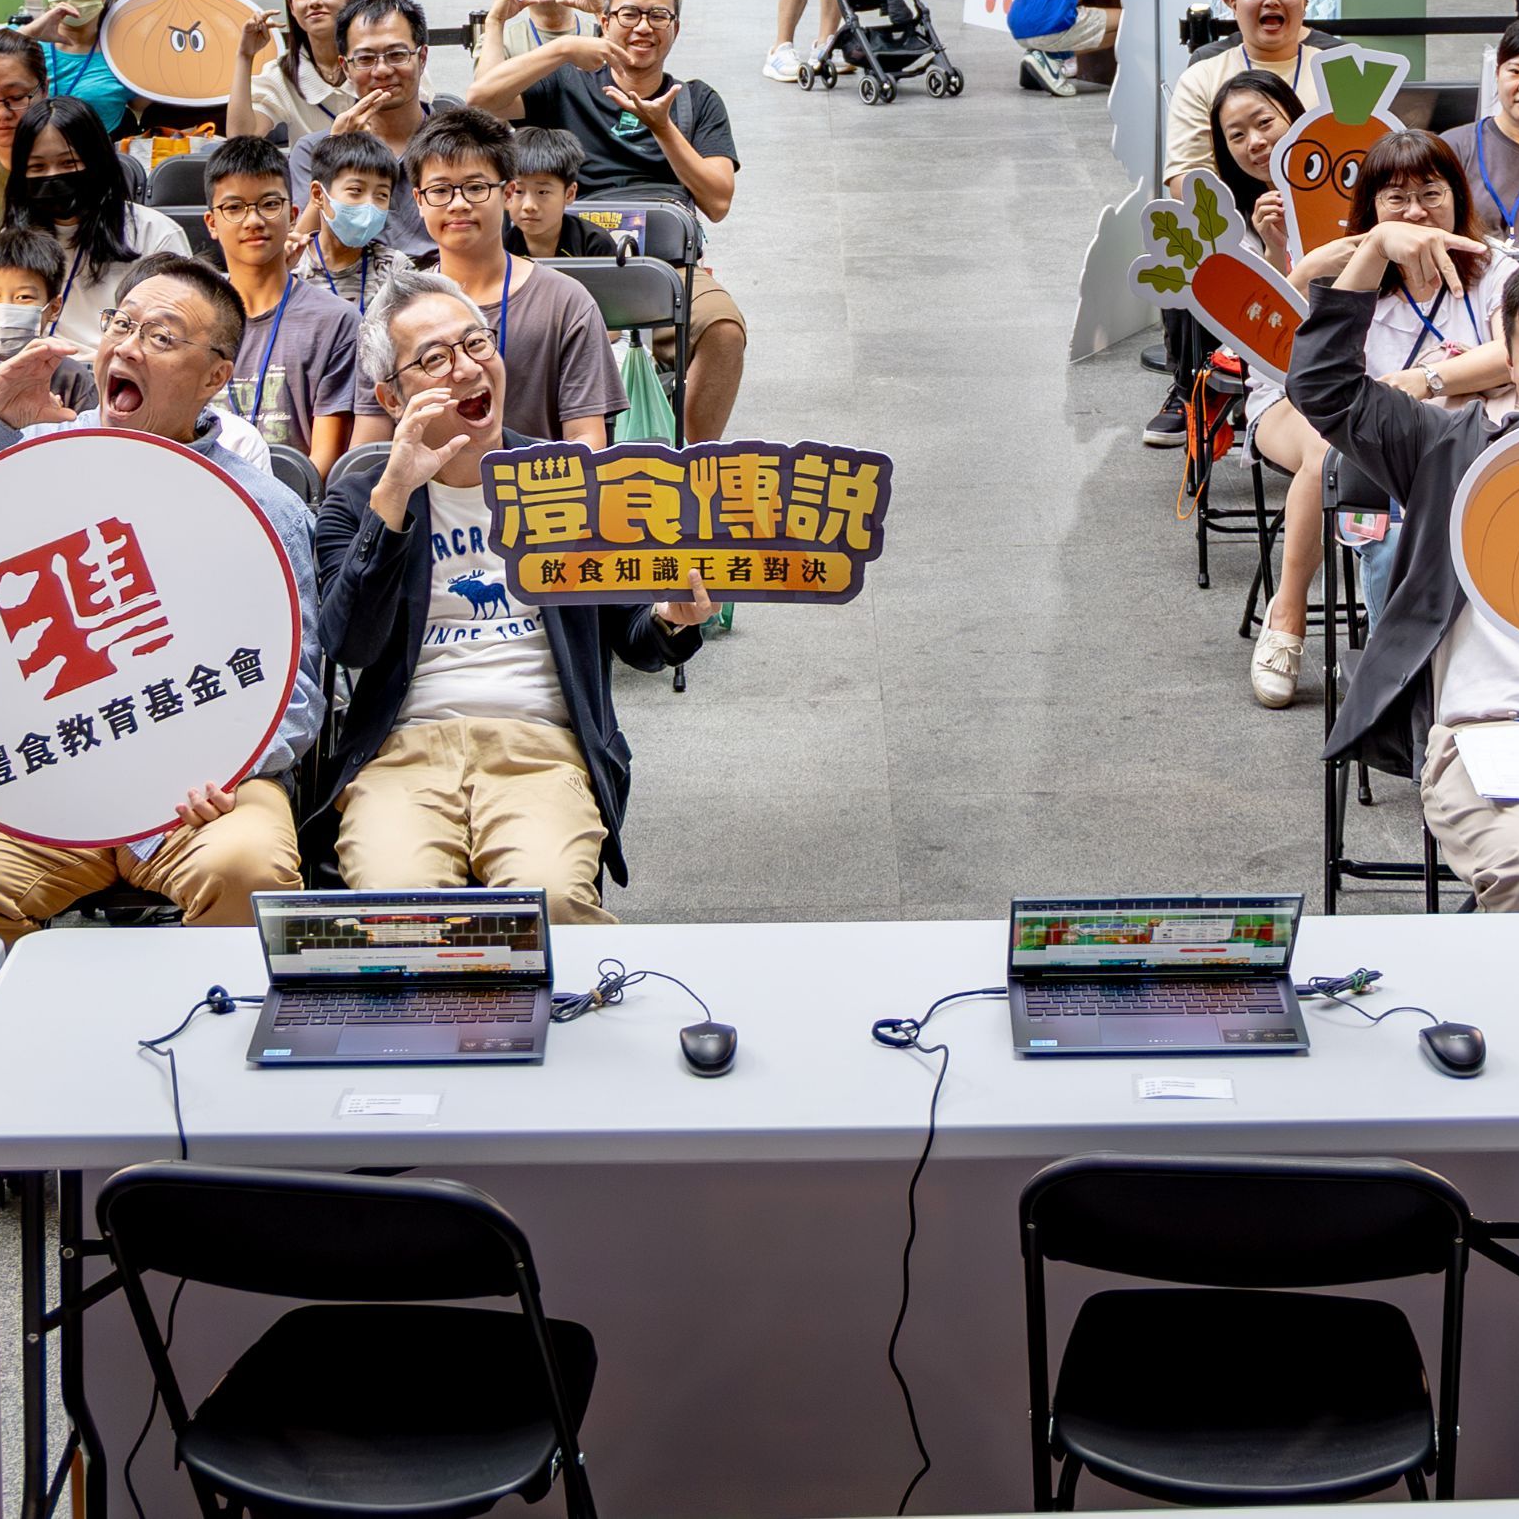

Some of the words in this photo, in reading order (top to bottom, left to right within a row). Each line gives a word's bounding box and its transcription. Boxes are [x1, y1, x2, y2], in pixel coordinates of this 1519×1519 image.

[493, 449, 881, 549] 灃食傳說
[538, 548, 828, 586] 飲食知識王者對決
